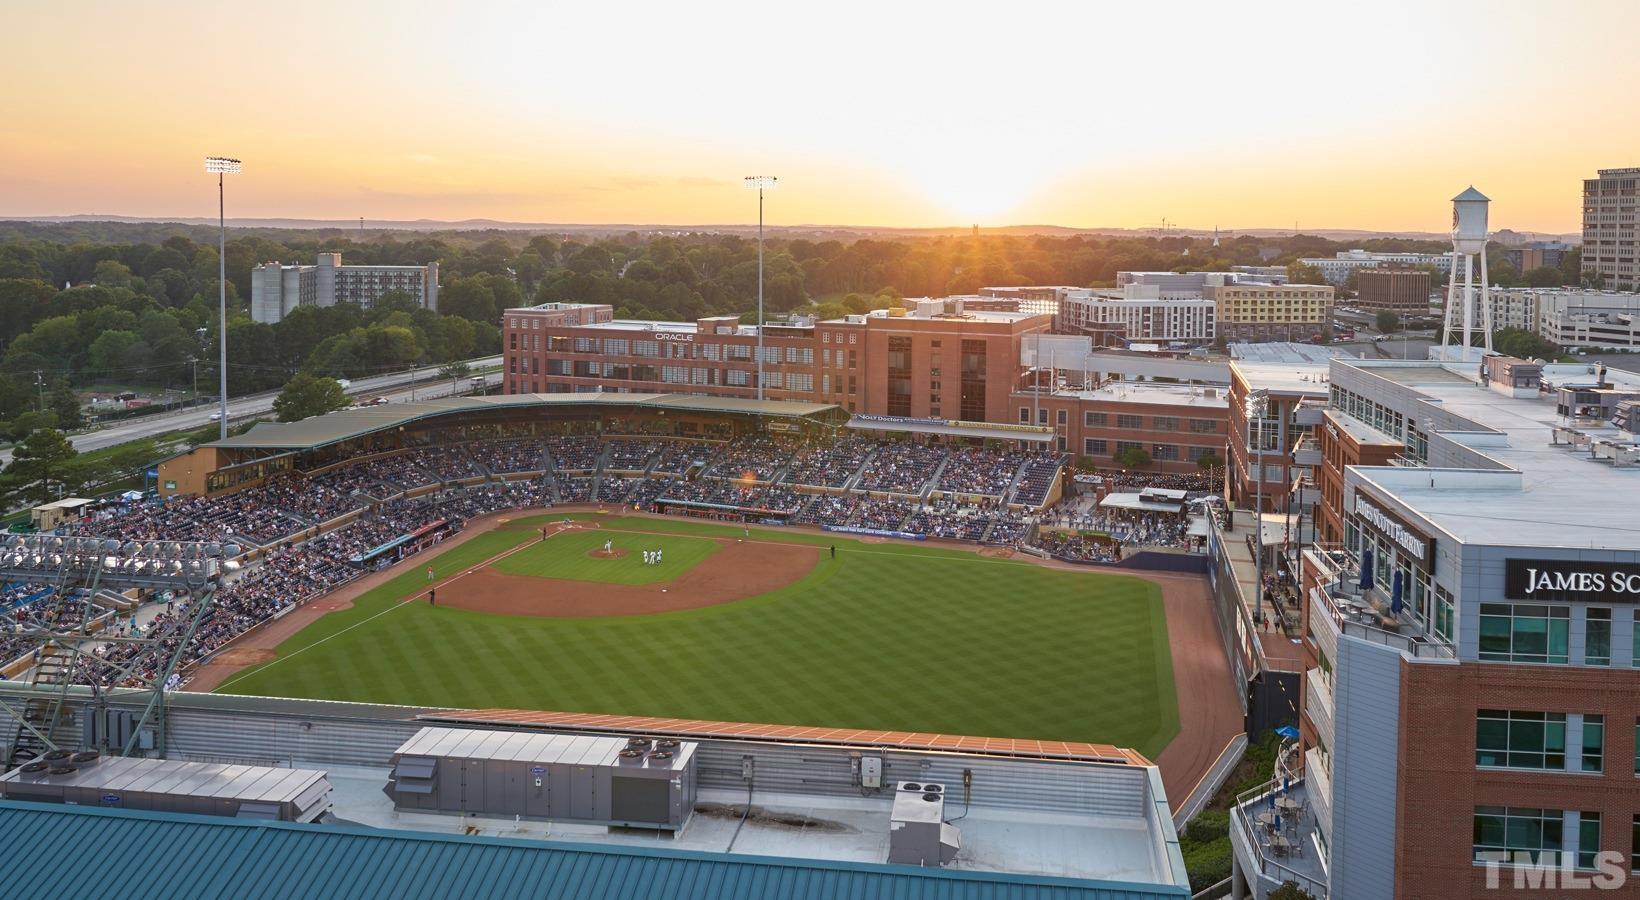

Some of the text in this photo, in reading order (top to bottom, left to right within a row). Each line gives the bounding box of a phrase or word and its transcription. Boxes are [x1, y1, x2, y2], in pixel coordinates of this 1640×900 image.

[655, 333, 694, 341] ORACLE
[1354, 494, 1425, 560] JAMES SCOTT FARRIN
[1525, 568, 1606, 594] JAMES
